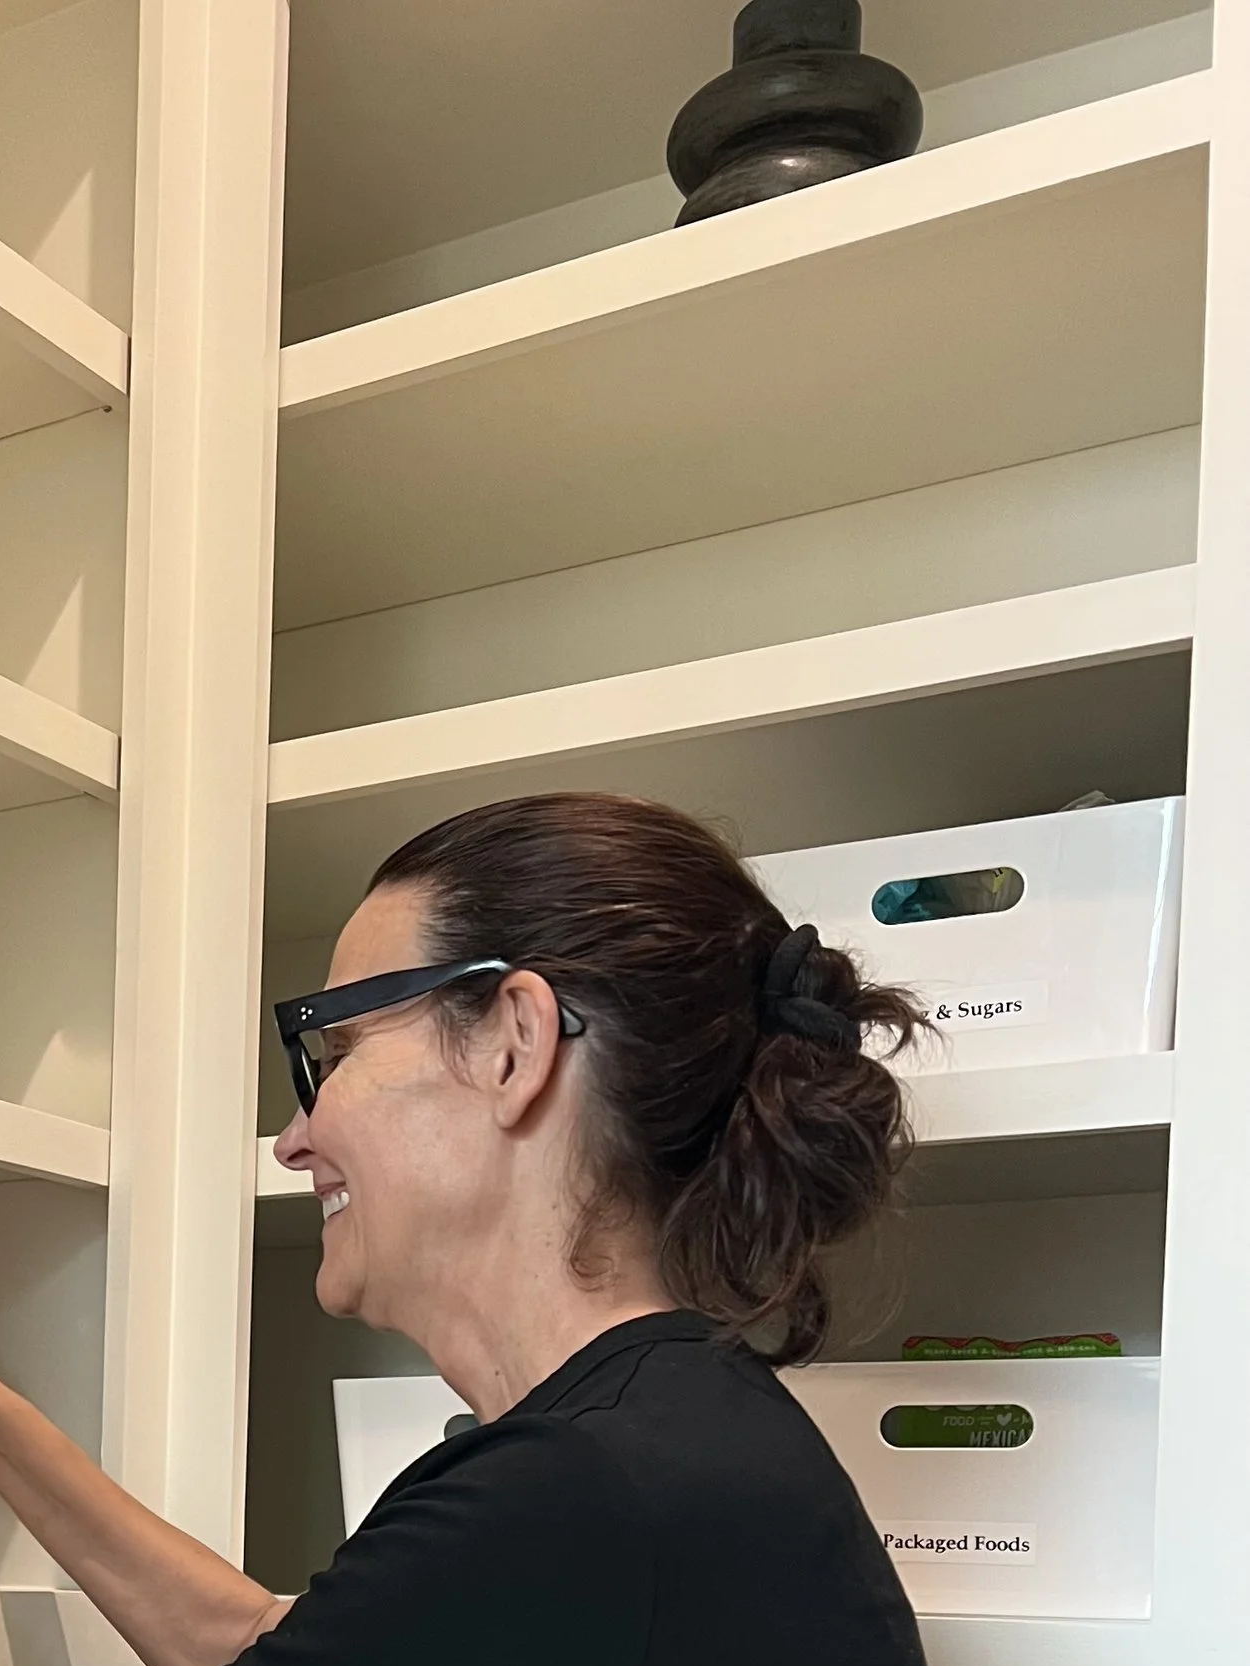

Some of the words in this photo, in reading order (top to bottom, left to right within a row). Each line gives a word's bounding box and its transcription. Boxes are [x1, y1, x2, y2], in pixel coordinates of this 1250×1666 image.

[936, 1004, 952, 1020] &
[958, 1000, 1022, 1019] Sugars
[942, 1416, 975, 1426] FOOD
[883, 1534, 968, 1554] Packaged
[974, 1536, 1030, 1552] Foods
